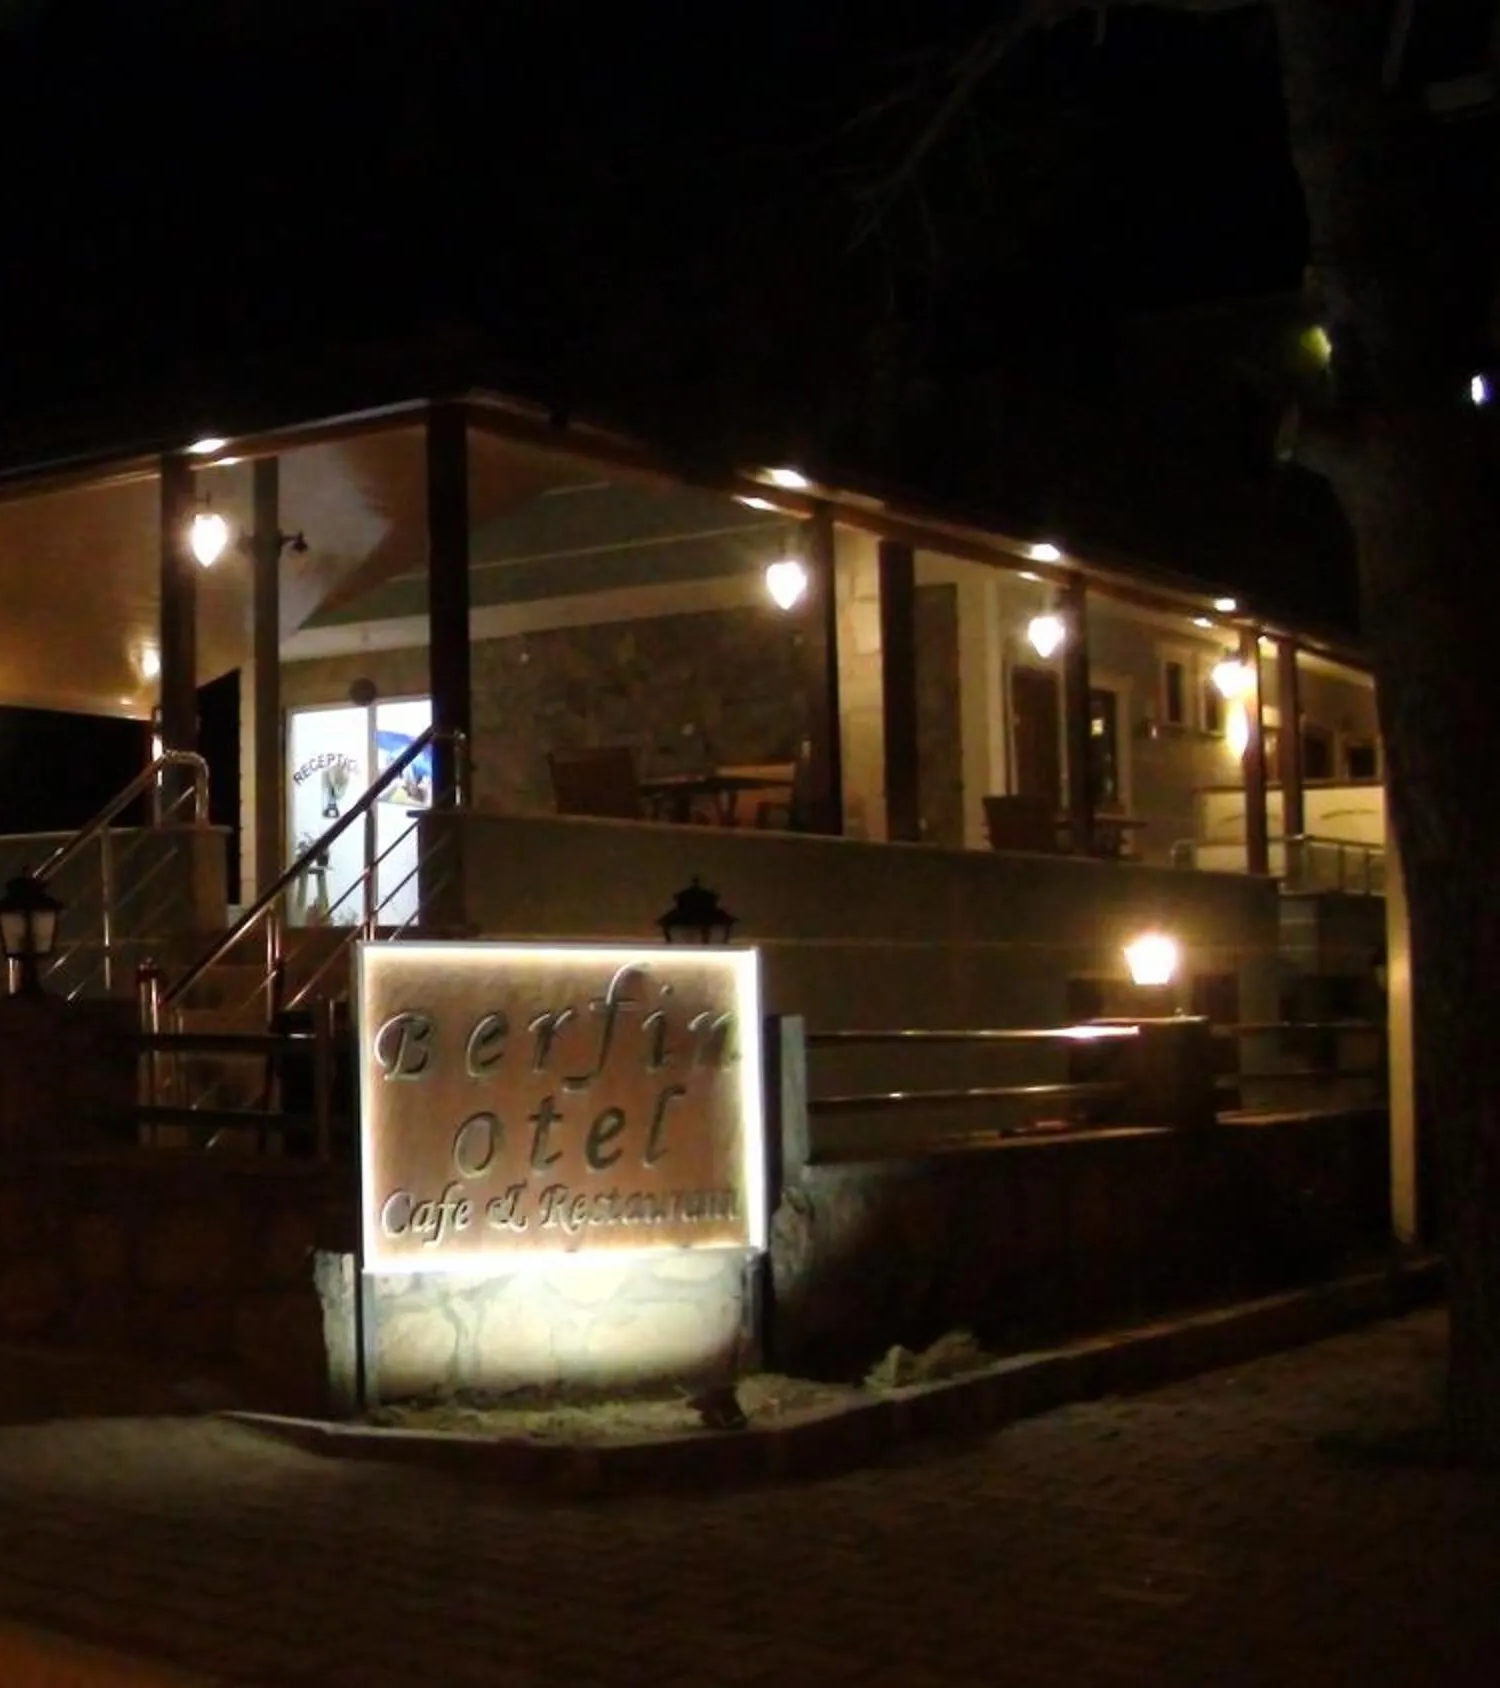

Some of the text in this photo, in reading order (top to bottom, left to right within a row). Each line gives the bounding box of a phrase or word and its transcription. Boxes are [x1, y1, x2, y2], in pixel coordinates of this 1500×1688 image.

[293, 752, 362, 786] RECEPTIO
[374, 962, 742, 1093] Berfin
[380, 1181, 475, 1246] Cafe
